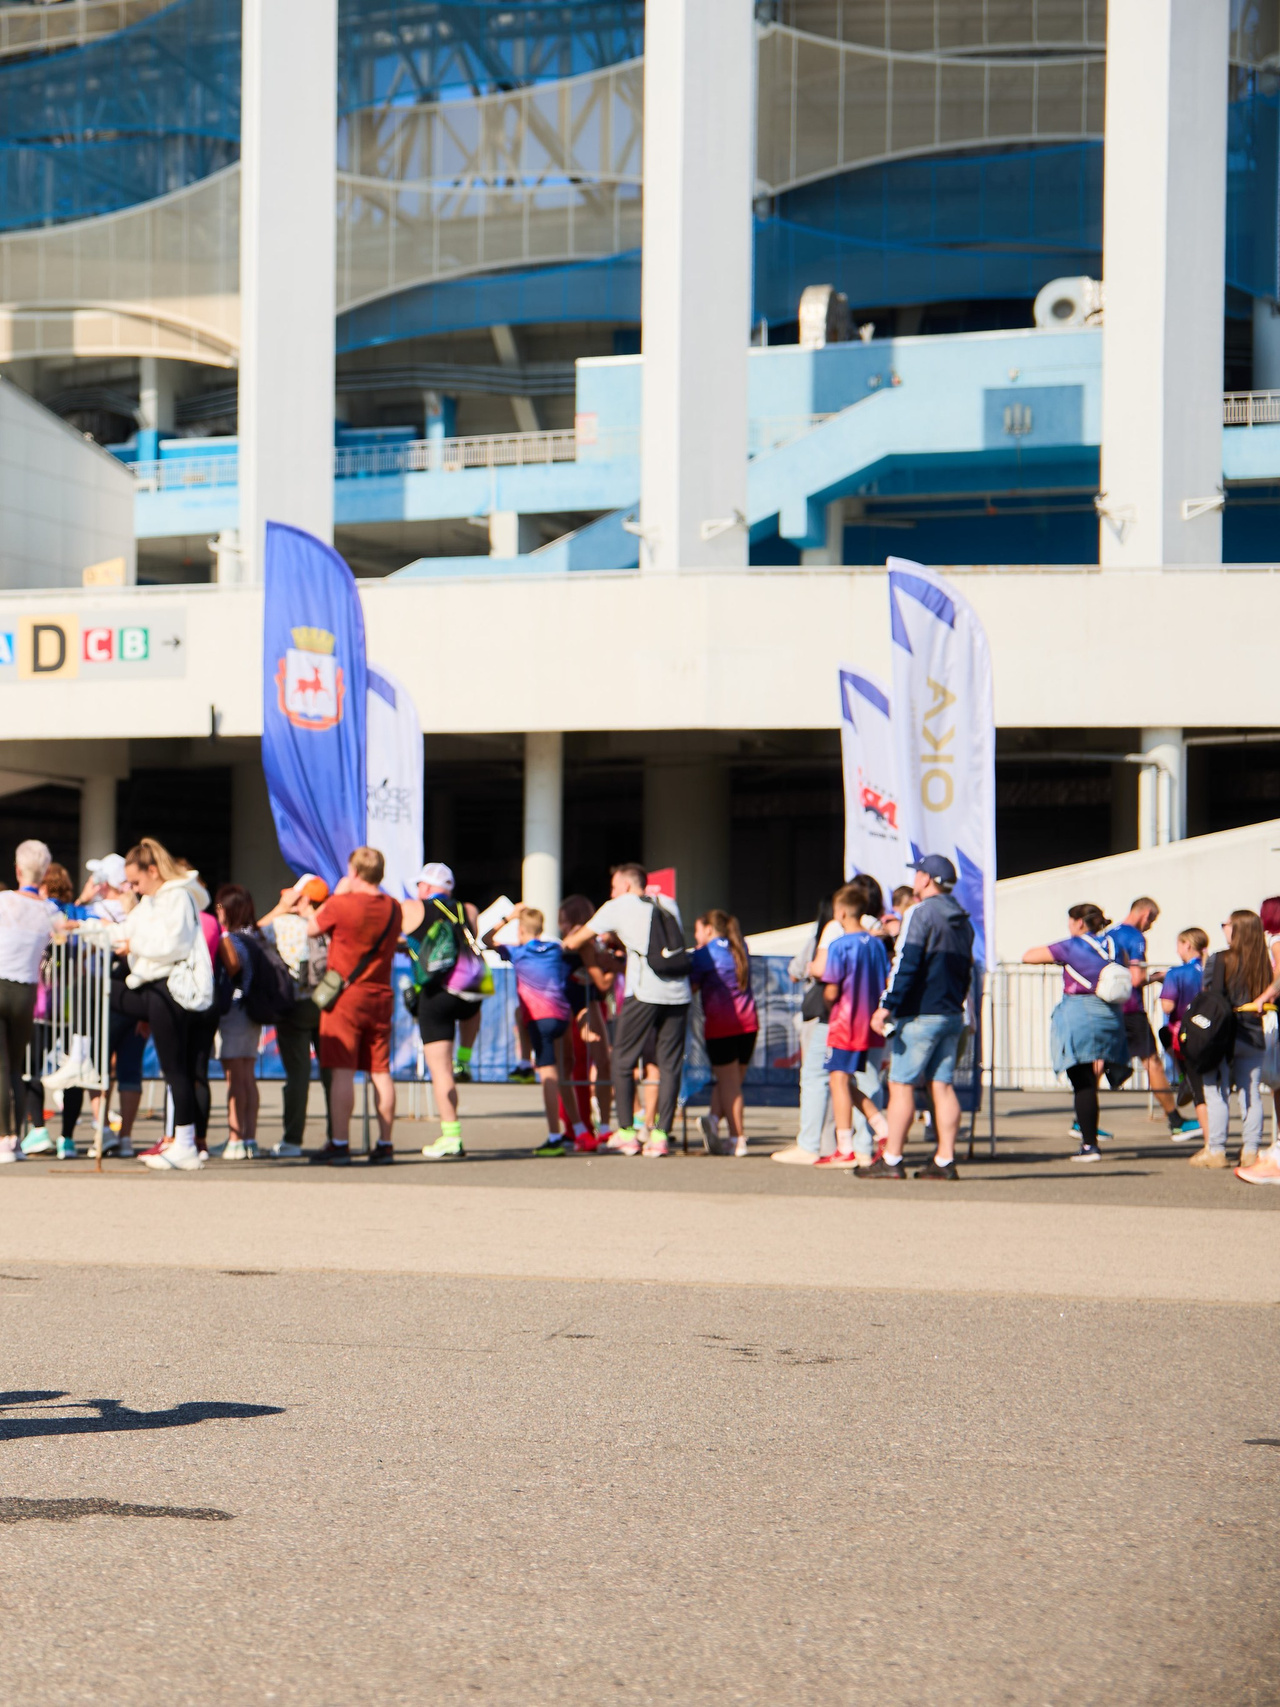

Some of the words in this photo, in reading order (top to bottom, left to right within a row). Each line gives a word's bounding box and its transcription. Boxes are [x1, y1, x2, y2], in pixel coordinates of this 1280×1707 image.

[33, 625, 66, 672] D
[86, 628, 111, 661] C
[121, 628, 148, 661] B
